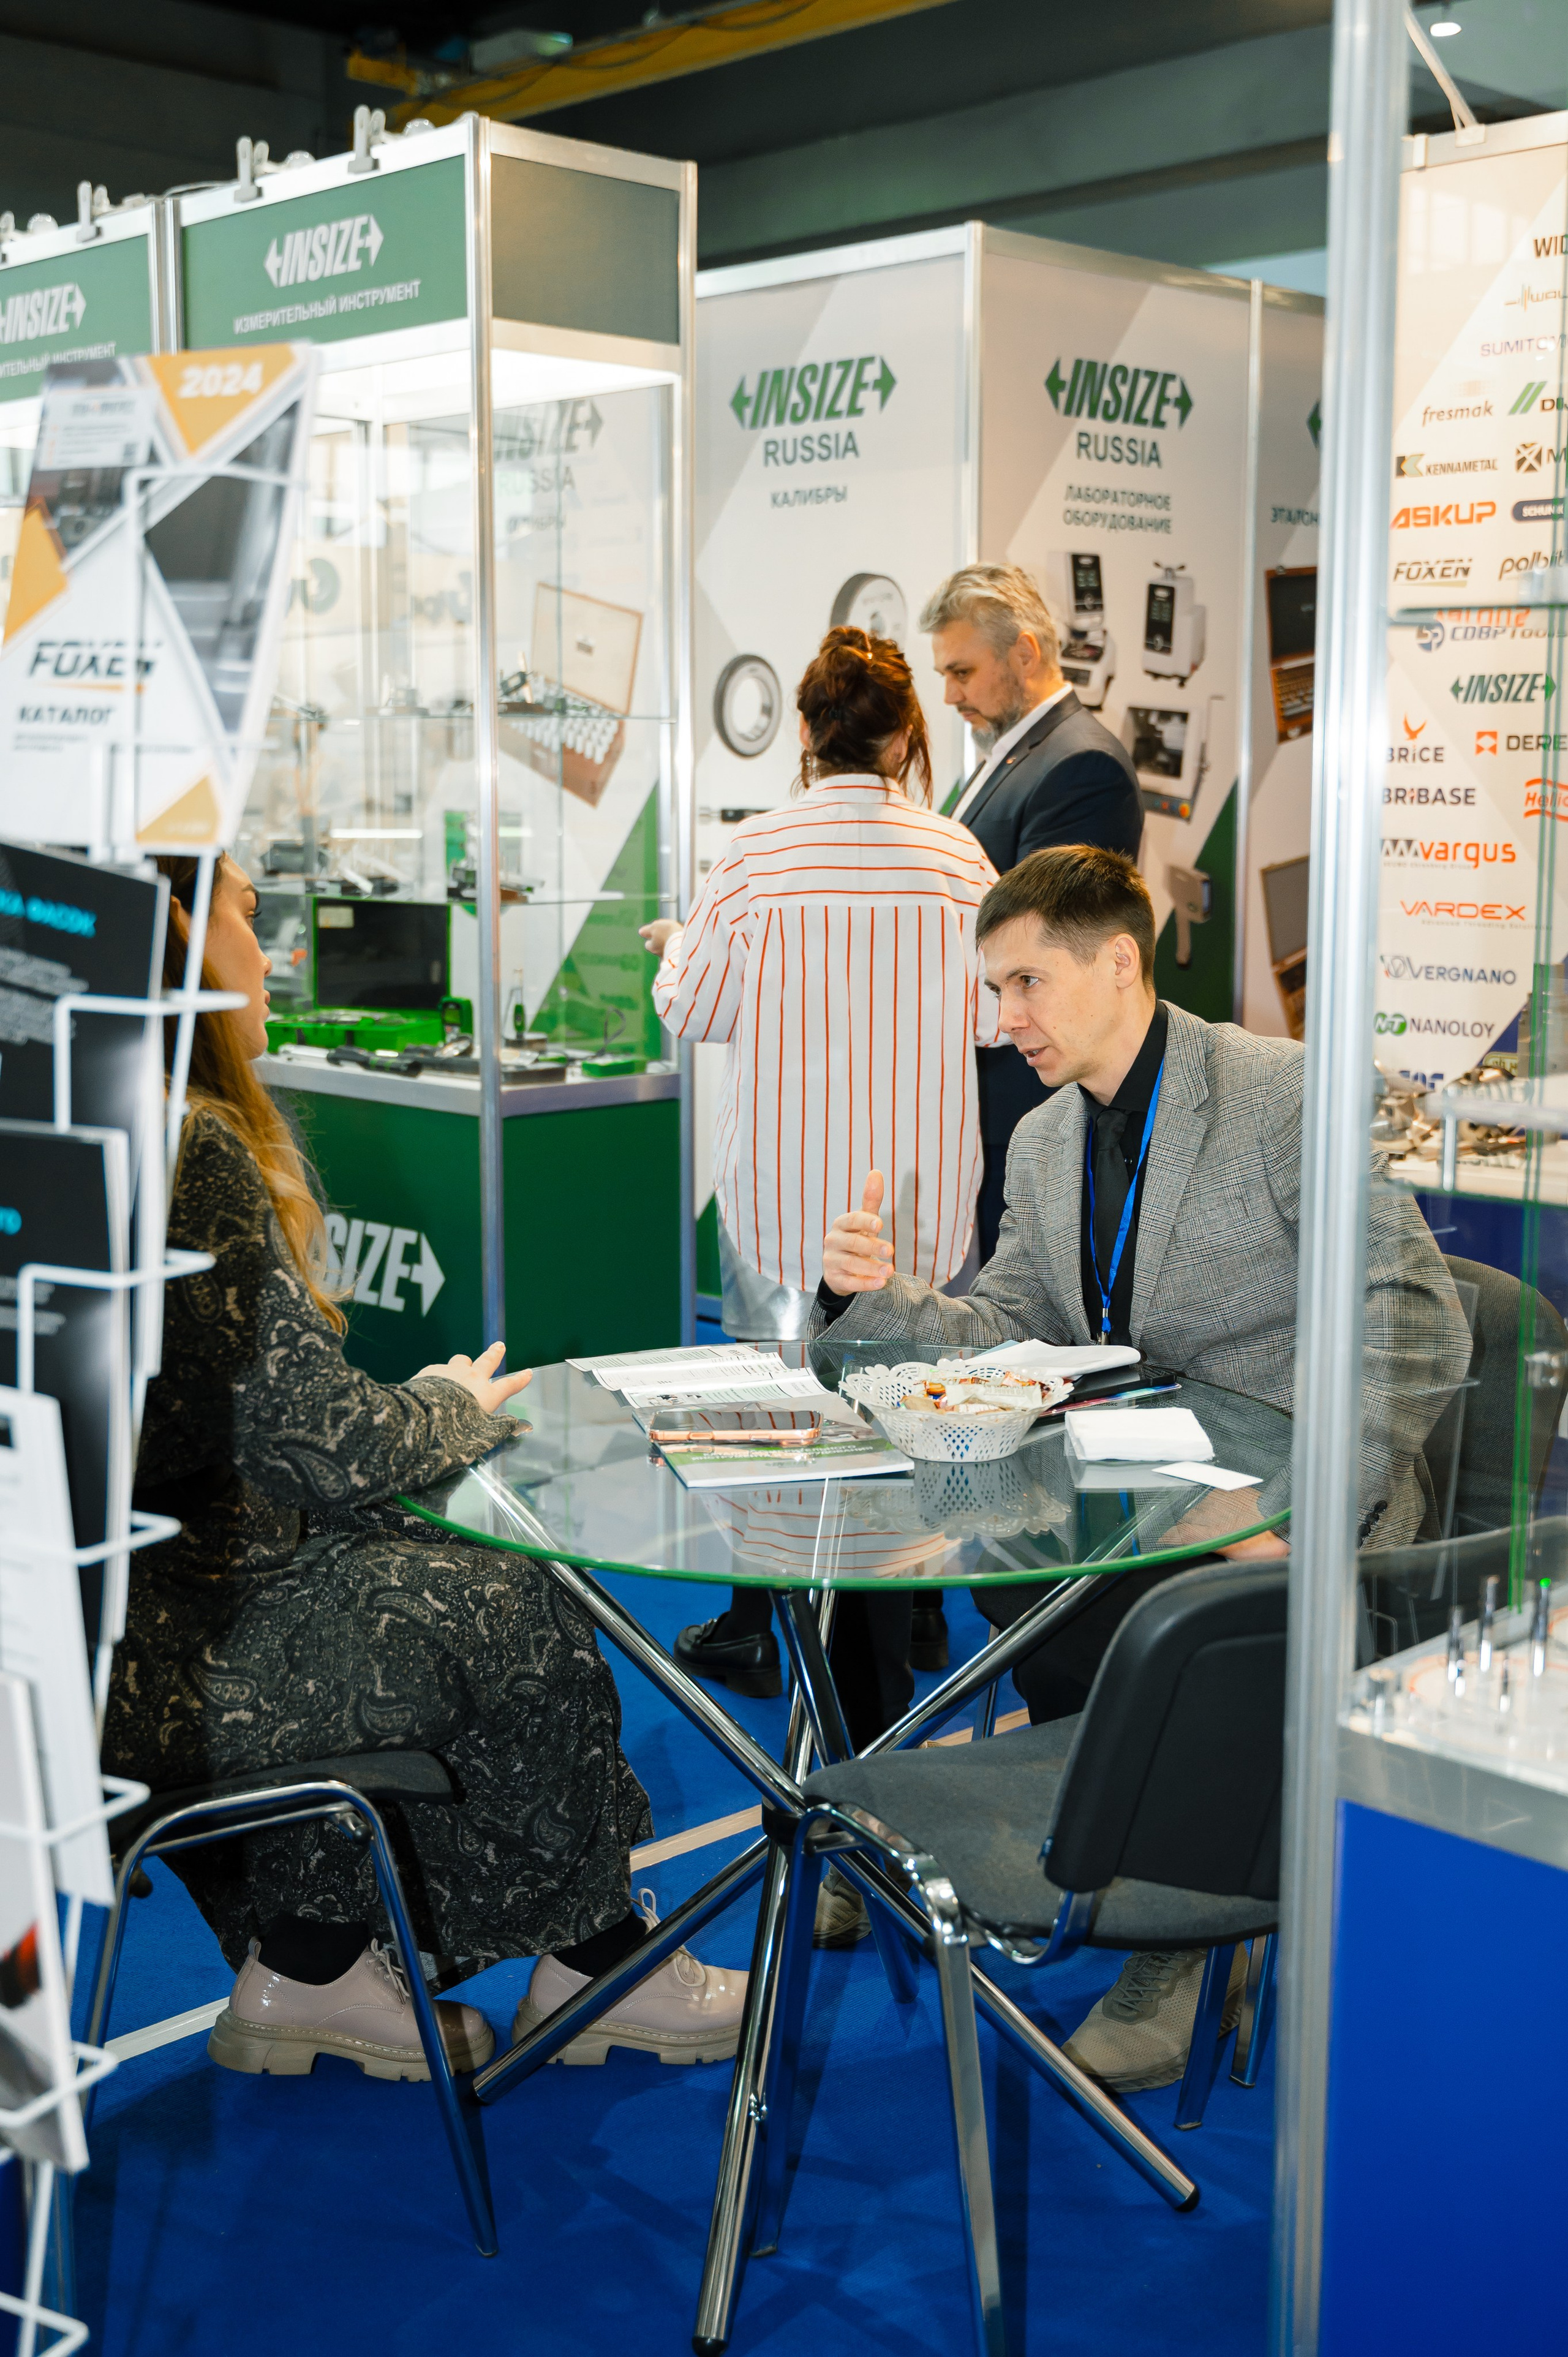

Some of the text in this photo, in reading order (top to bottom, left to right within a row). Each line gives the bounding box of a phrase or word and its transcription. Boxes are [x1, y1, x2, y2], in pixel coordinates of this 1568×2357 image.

[279, 215, 369, 288] INSIZE
[2, 282, 75, 344] INSIZE
[233, 278, 421, 334] ИЗМЕРИТЕЛЬНЫЙ ИНСТРУМЕНТ
[178, 363, 265, 399] 2024
[748, 354, 876, 430] INSIZE
[1063, 358, 1177, 429] INSIZE
[1422, 401, 1494, 427] fresmak
[763, 430, 861, 468] RUSSIA
[1076, 431, 1162, 469] RUSSIA
[1425, 458, 1499, 477] KENNAMETAL
[770, 485, 848, 509] КАЛИБРЫ
[1064, 484, 1172, 511] ЛАБОРАТОРНОЕ
[1063, 508, 1172, 535] ОБОРУДОВАНИЕ
[1390, 501, 1497, 530] ASKUP
[1393, 557, 1473, 581] FOXEN
[1463, 673, 1544, 704] INSIZE
[18, 704, 115, 726] КАТАЛОГ
[1419, 841, 1517, 870] vargus
[1400, 900, 1526, 921] VARDEX
[1406, 957, 1516, 985] VERGNANO
[1410, 1017, 1495, 1039] NANOLOY
[323, 1212, 419, 1313] SIZE
